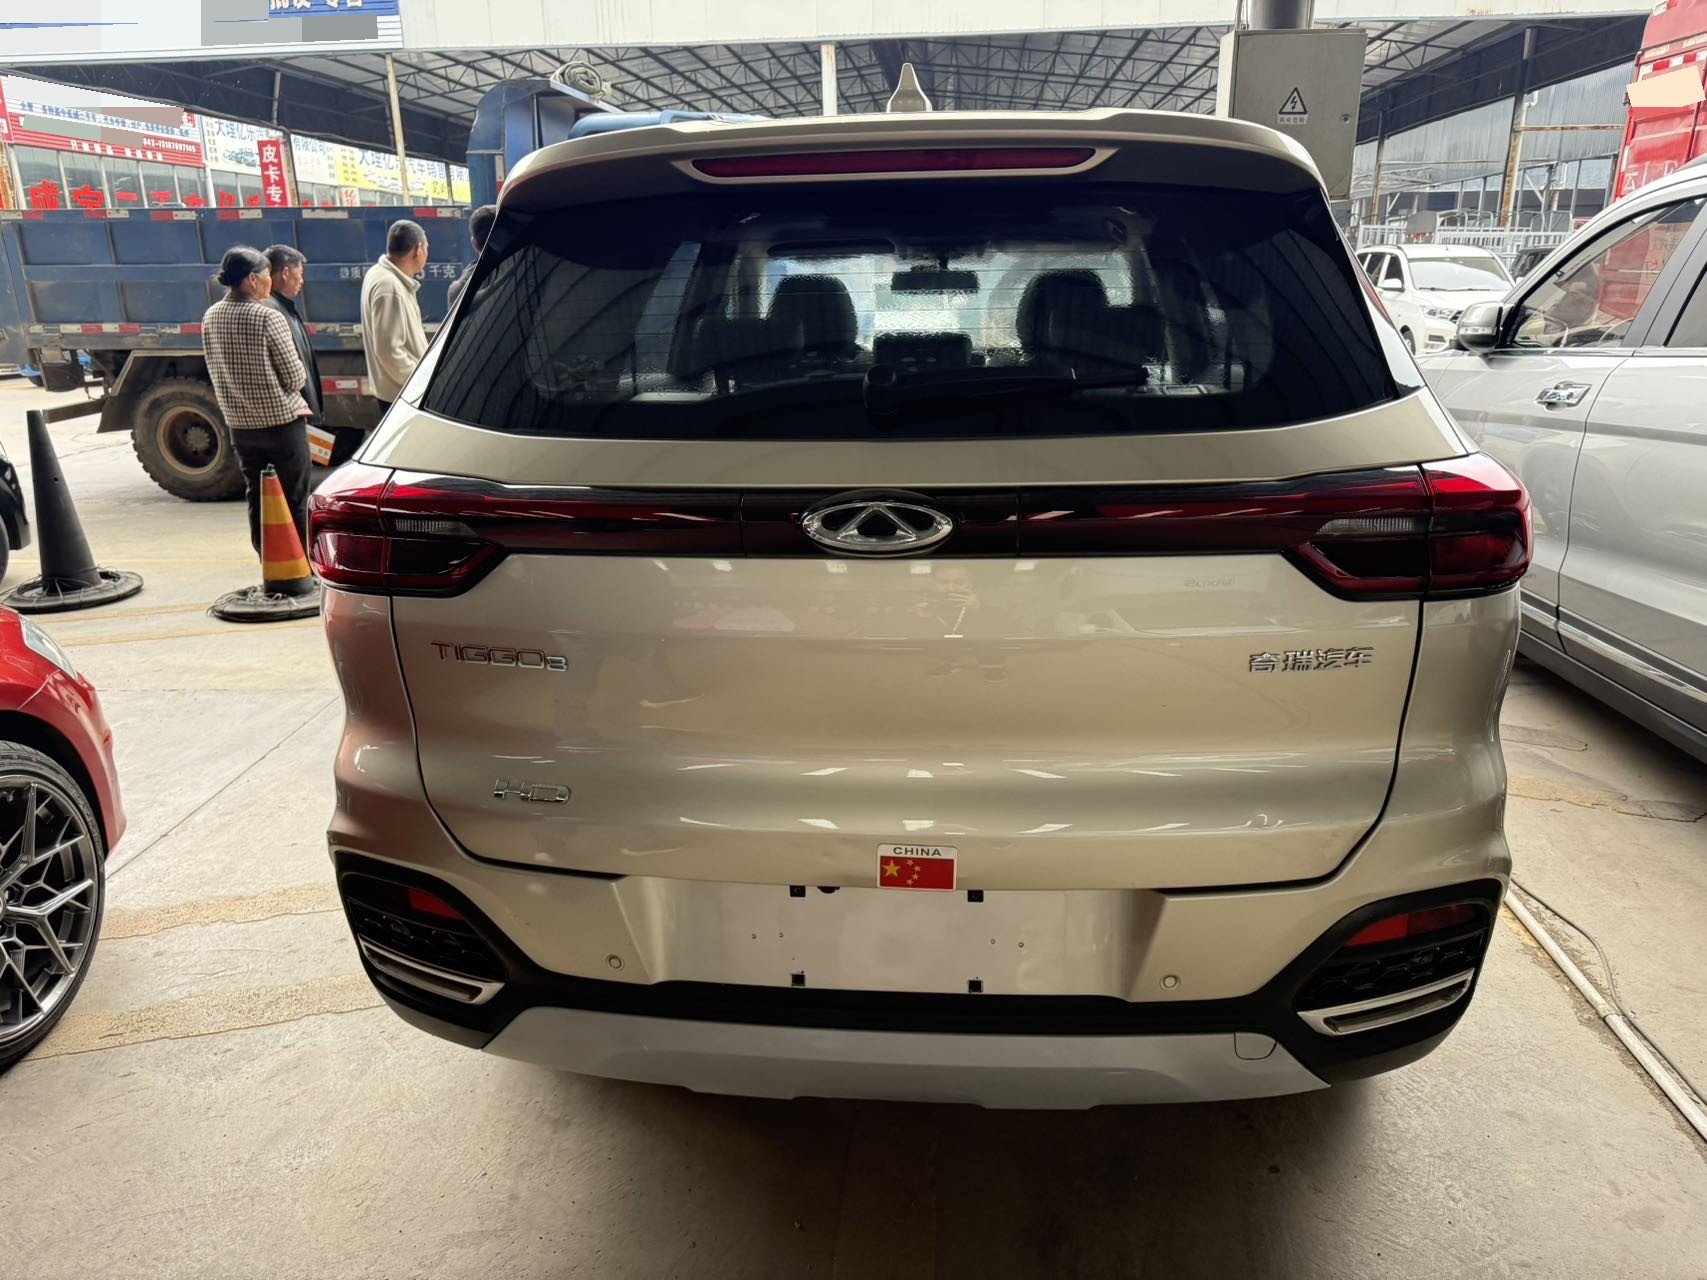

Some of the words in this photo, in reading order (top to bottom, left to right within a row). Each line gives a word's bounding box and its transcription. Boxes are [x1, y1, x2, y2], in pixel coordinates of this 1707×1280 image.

[261, 143, 284, 207] 皮卡专
[429, 263, 457, 279] 千克
[1248, 647, 1374, 673] 奇瑞汽车
[892, 846, 942, 857] CHINA
